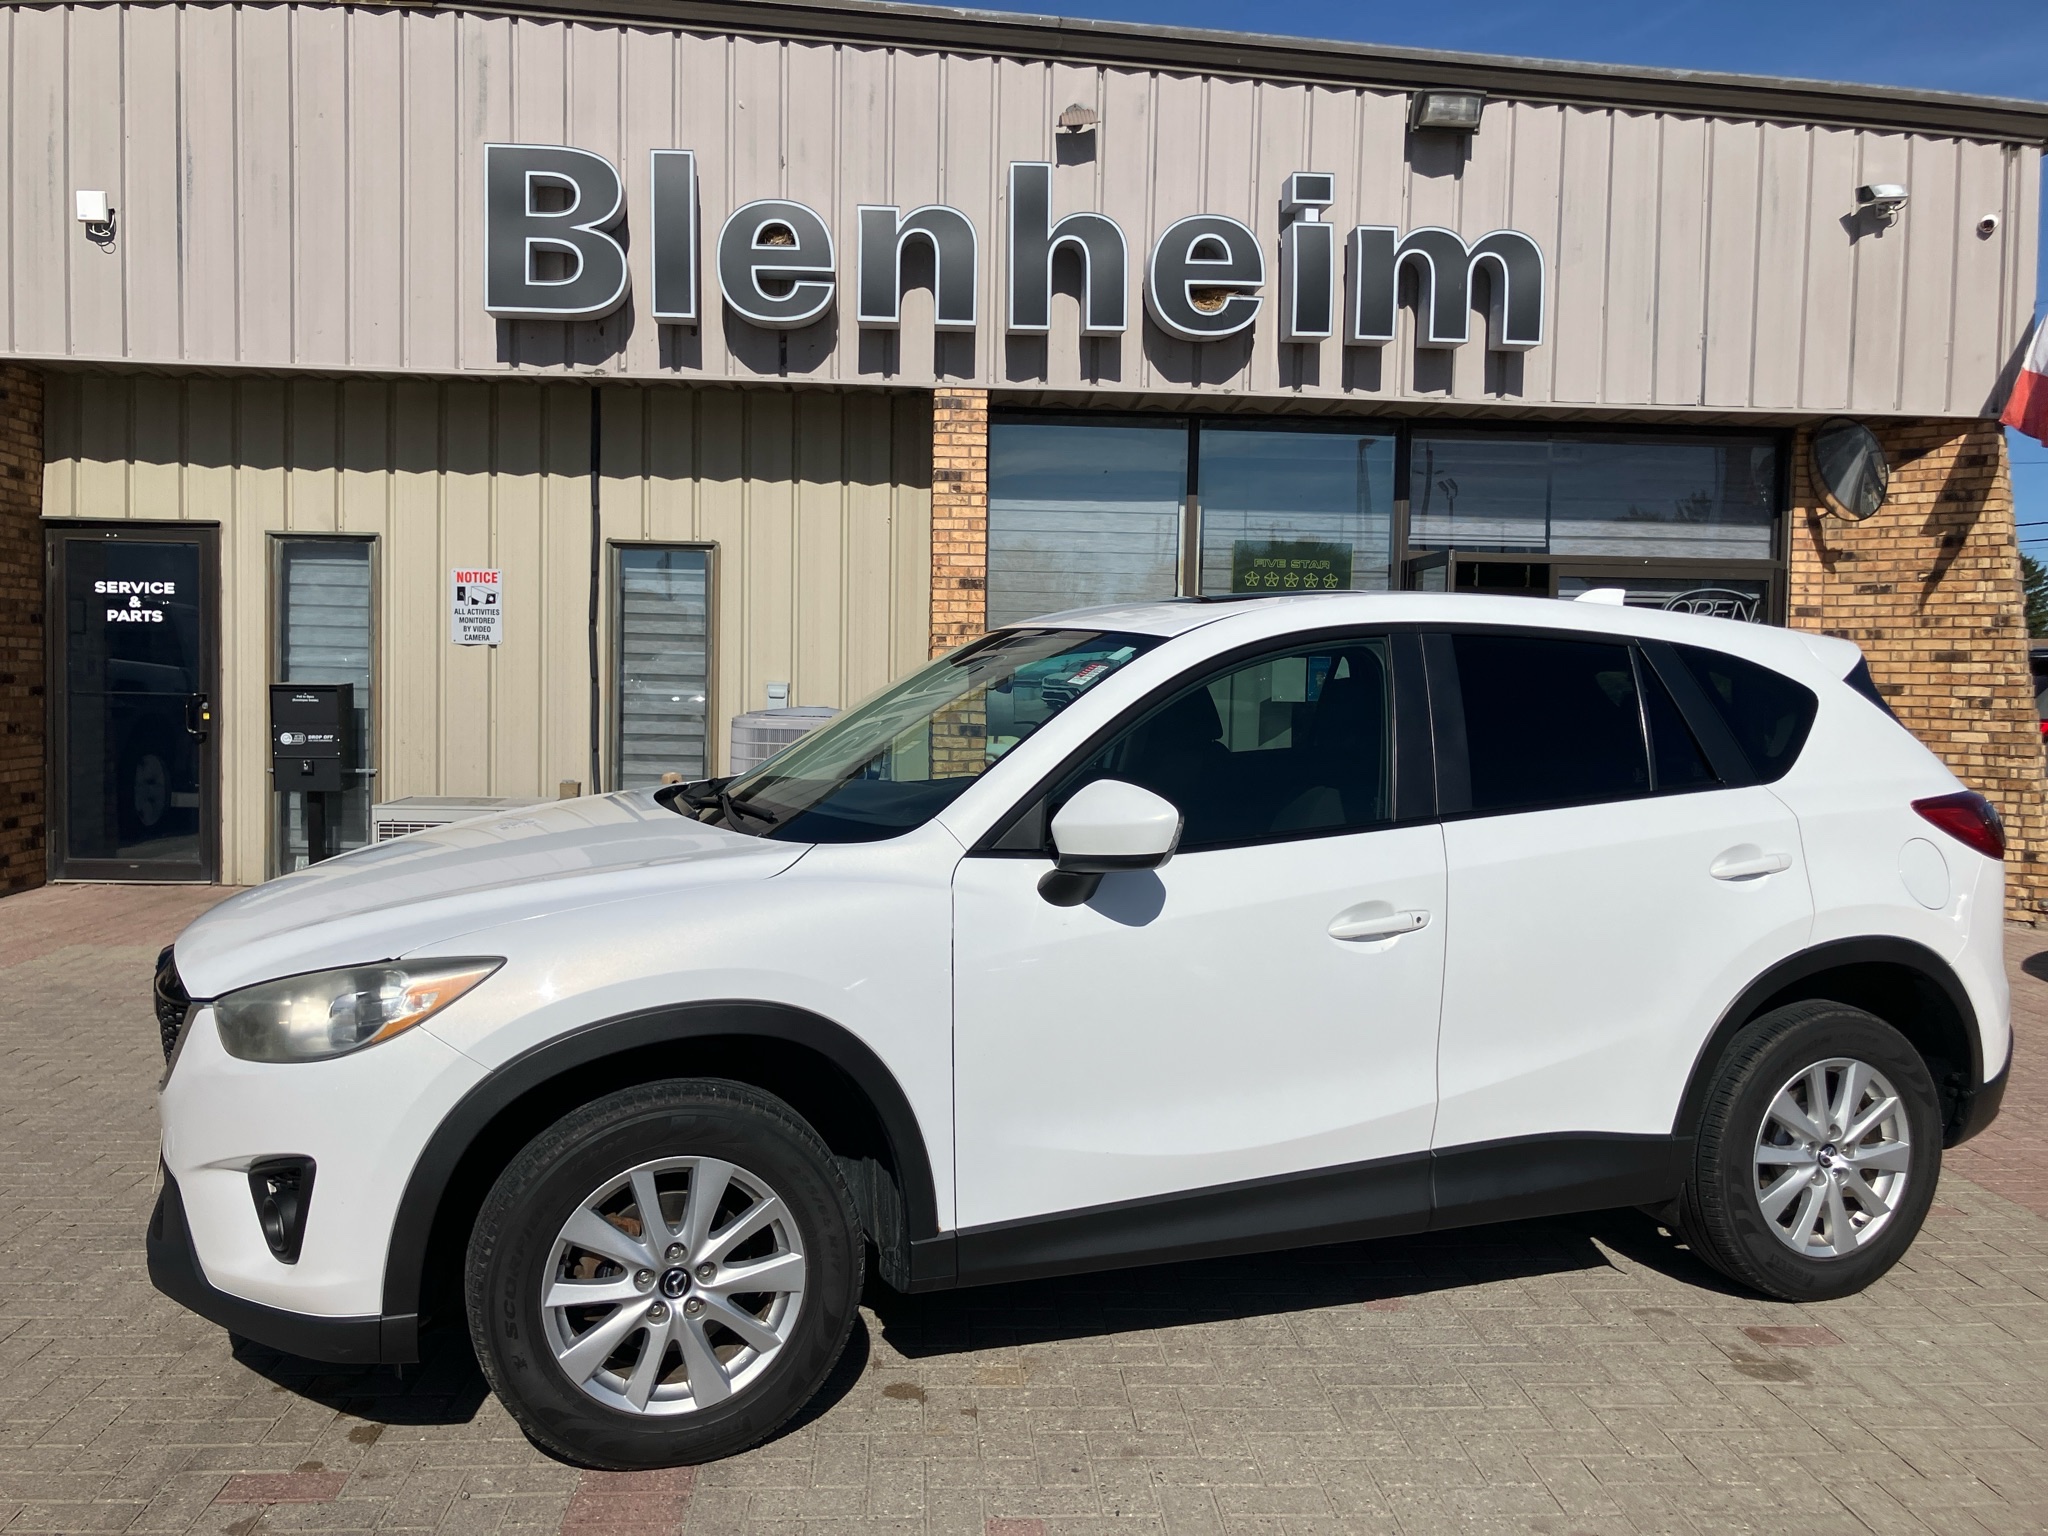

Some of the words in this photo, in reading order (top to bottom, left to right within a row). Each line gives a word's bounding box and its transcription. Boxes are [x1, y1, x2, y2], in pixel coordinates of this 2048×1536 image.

[484, 143, 1544, 349] Blenheim
[1253, 558, 1287, 568] FIVE
[1290, 559, 1331, 570] STAR
[456, 571, 498, 583] NOTICE
[94, 581, 175, 594] SERVICE
[128, 595, 142, 608] &
[106, 609, 163, 622] PARTS
[467, 608, 500, 616] ACTIVITIES
[458, 616, 495, 624] MONITORED
